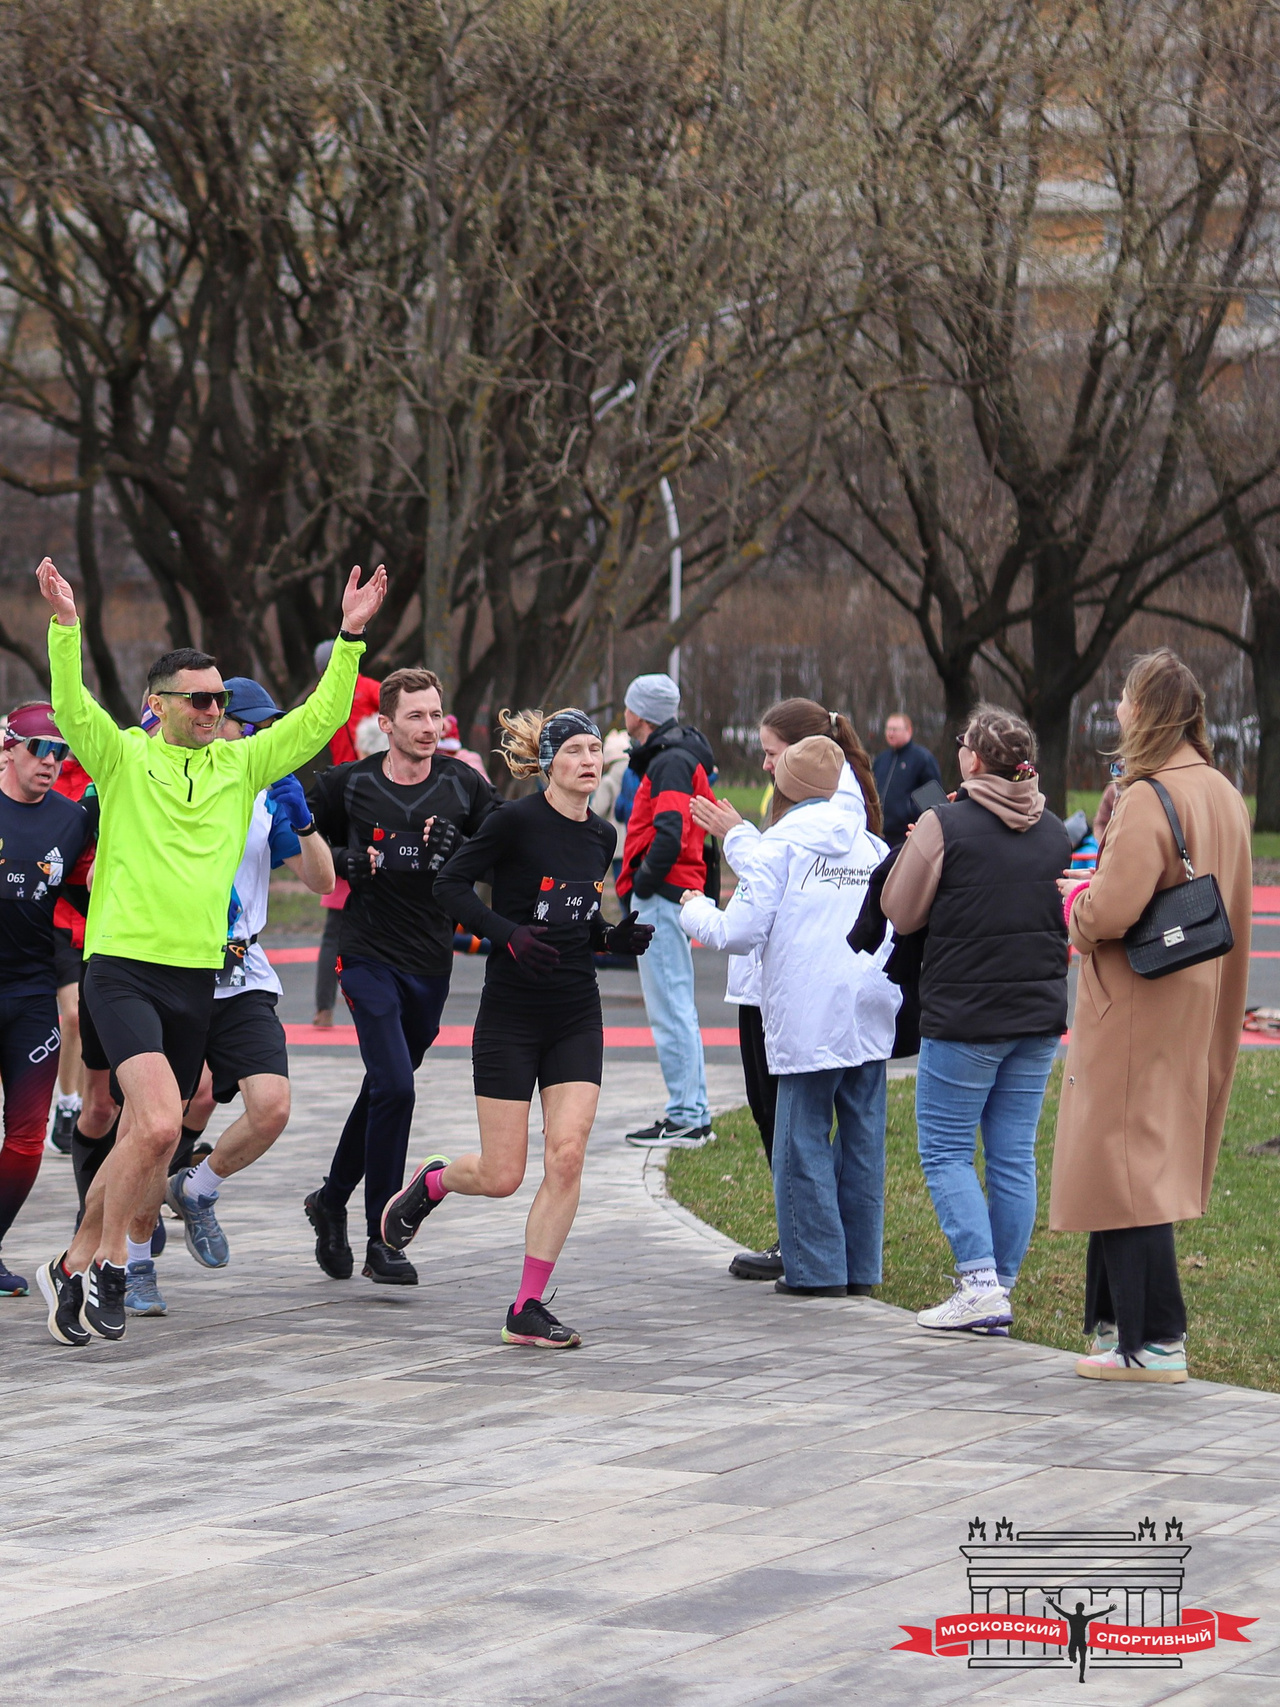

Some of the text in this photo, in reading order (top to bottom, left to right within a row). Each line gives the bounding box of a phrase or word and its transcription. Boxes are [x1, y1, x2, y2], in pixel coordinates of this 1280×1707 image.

[399, 845, 419, 856] 032
[44, 854, 64, 863] adidas
[6, 872, 25, 884] 065
[564, 896, 584, 907] 146
[28, 1026, 60, 1064] odl
